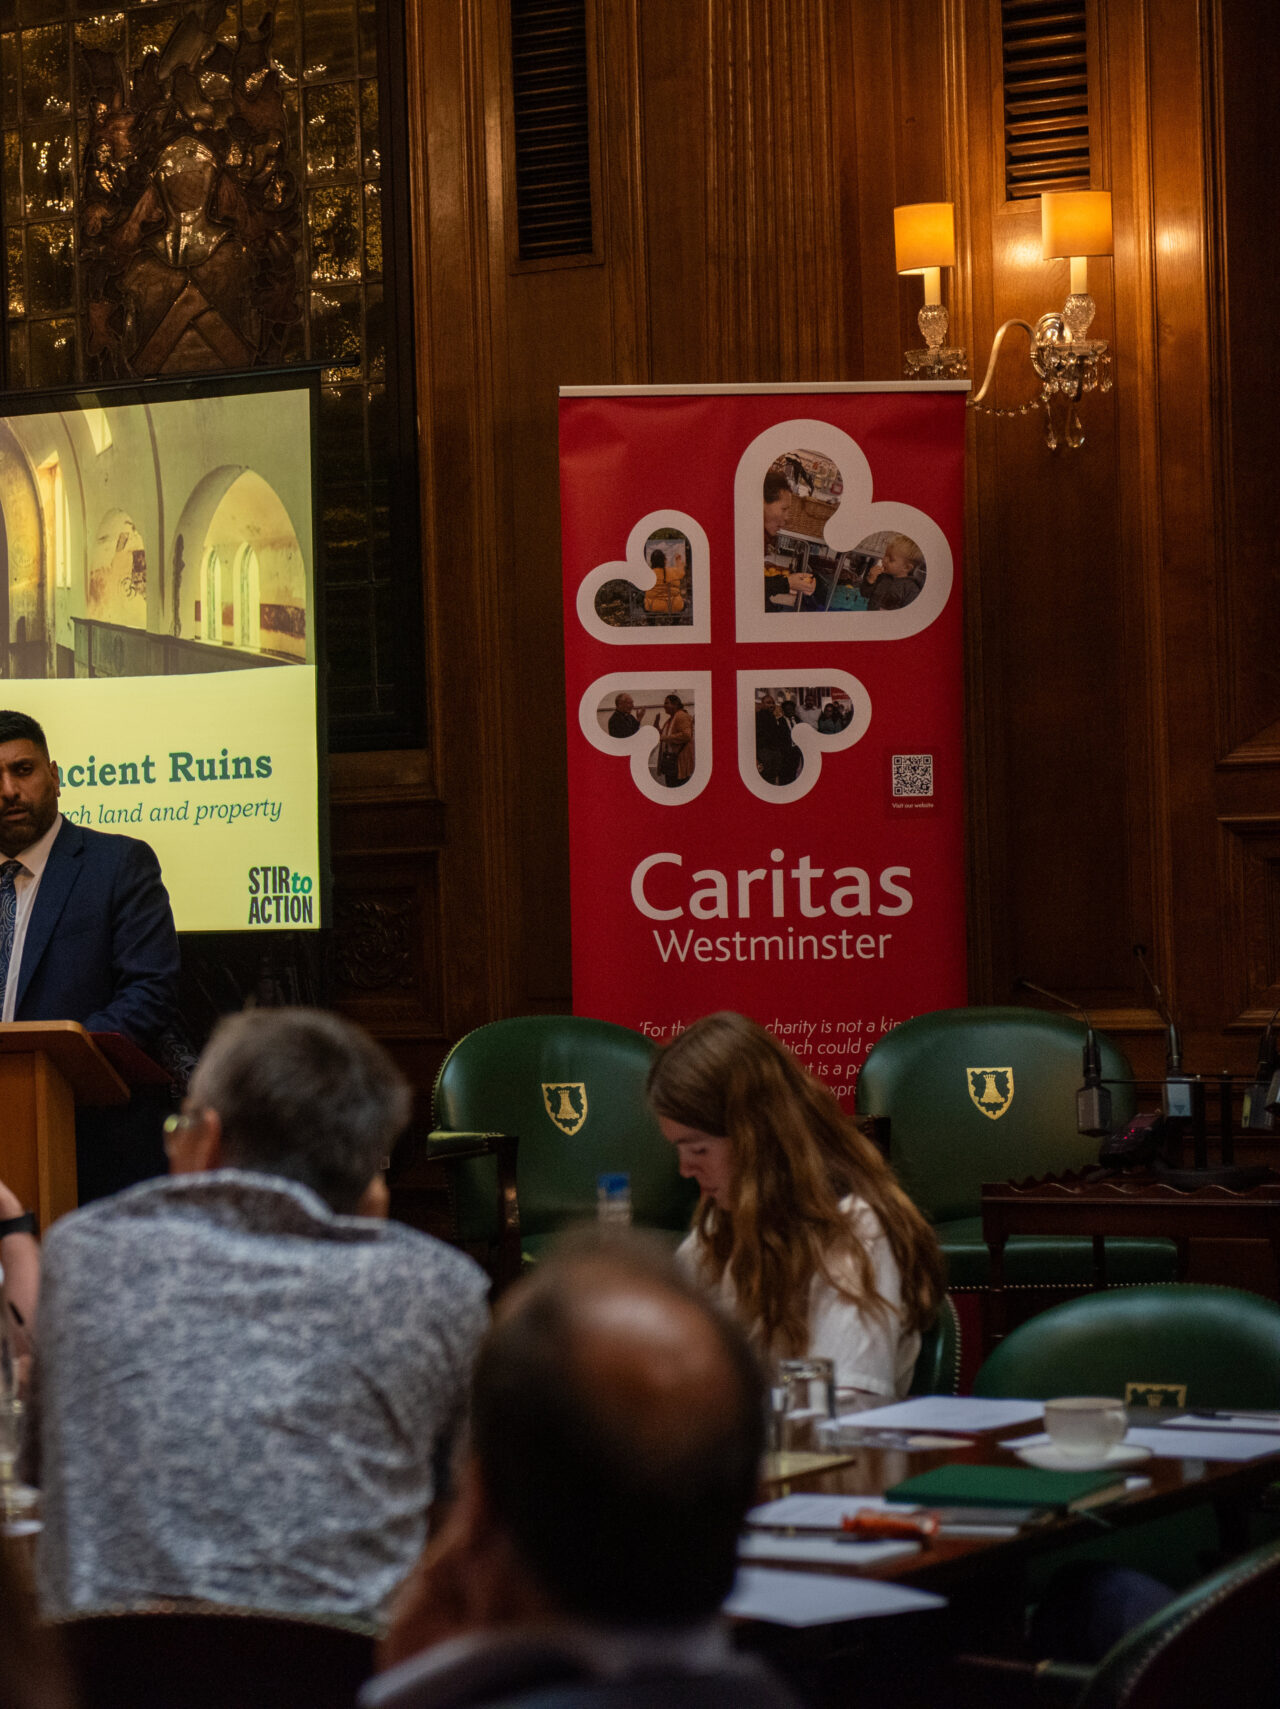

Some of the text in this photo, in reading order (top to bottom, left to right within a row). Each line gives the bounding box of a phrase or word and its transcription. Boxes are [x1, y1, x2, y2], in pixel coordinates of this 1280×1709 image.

[57, 755, 156, 788] cient
[169, 748, 273, 783] Ruins
[98, 802, 143, 825] land
[149, 800, 189, 822] and
[193, 798, 283, 826] property
[630, 848, 914, 921] Caritas
[248, 895, 313, 924] ACTION
[652, 926, 892, 963] Westminster
[671, 1020, 686, 1036] th
[765, 1017, 818, 1039] charity
[821, 1019, 832, 1033] is
[836, 1019, 863, 1033] not
[866, 1022, 876, 1033] a
[782, 1038, 813, 1056] hich
[817, 1037, 862, 1055] could
[818, 1061, 829, 1076] is
[832, 1064, 842, 1076] a
